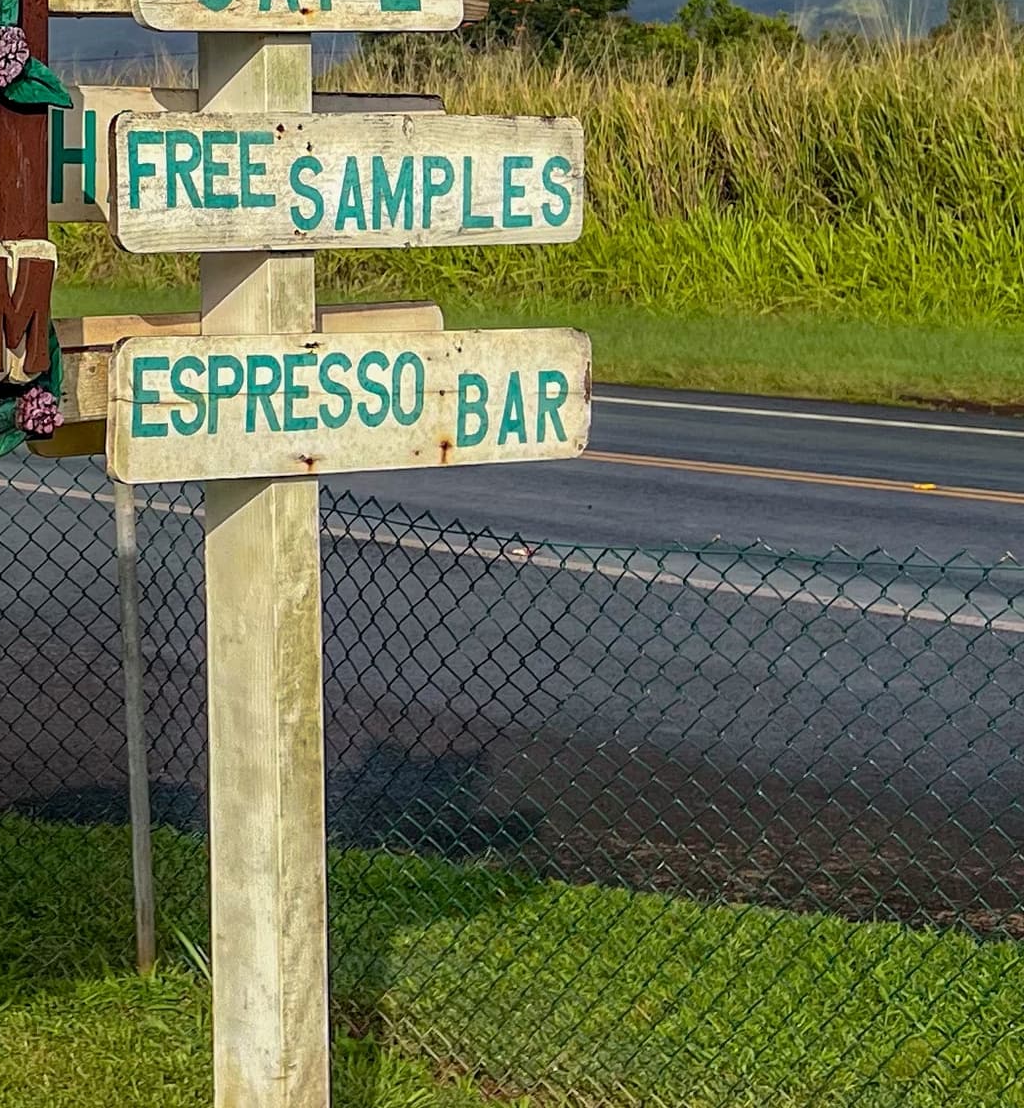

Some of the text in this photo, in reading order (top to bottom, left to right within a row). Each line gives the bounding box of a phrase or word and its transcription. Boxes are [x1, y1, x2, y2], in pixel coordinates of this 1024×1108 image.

[127, 130, 573, 232] FREE SAMPLES
[131, 351, 568, 448] ESPRESSO BAR
